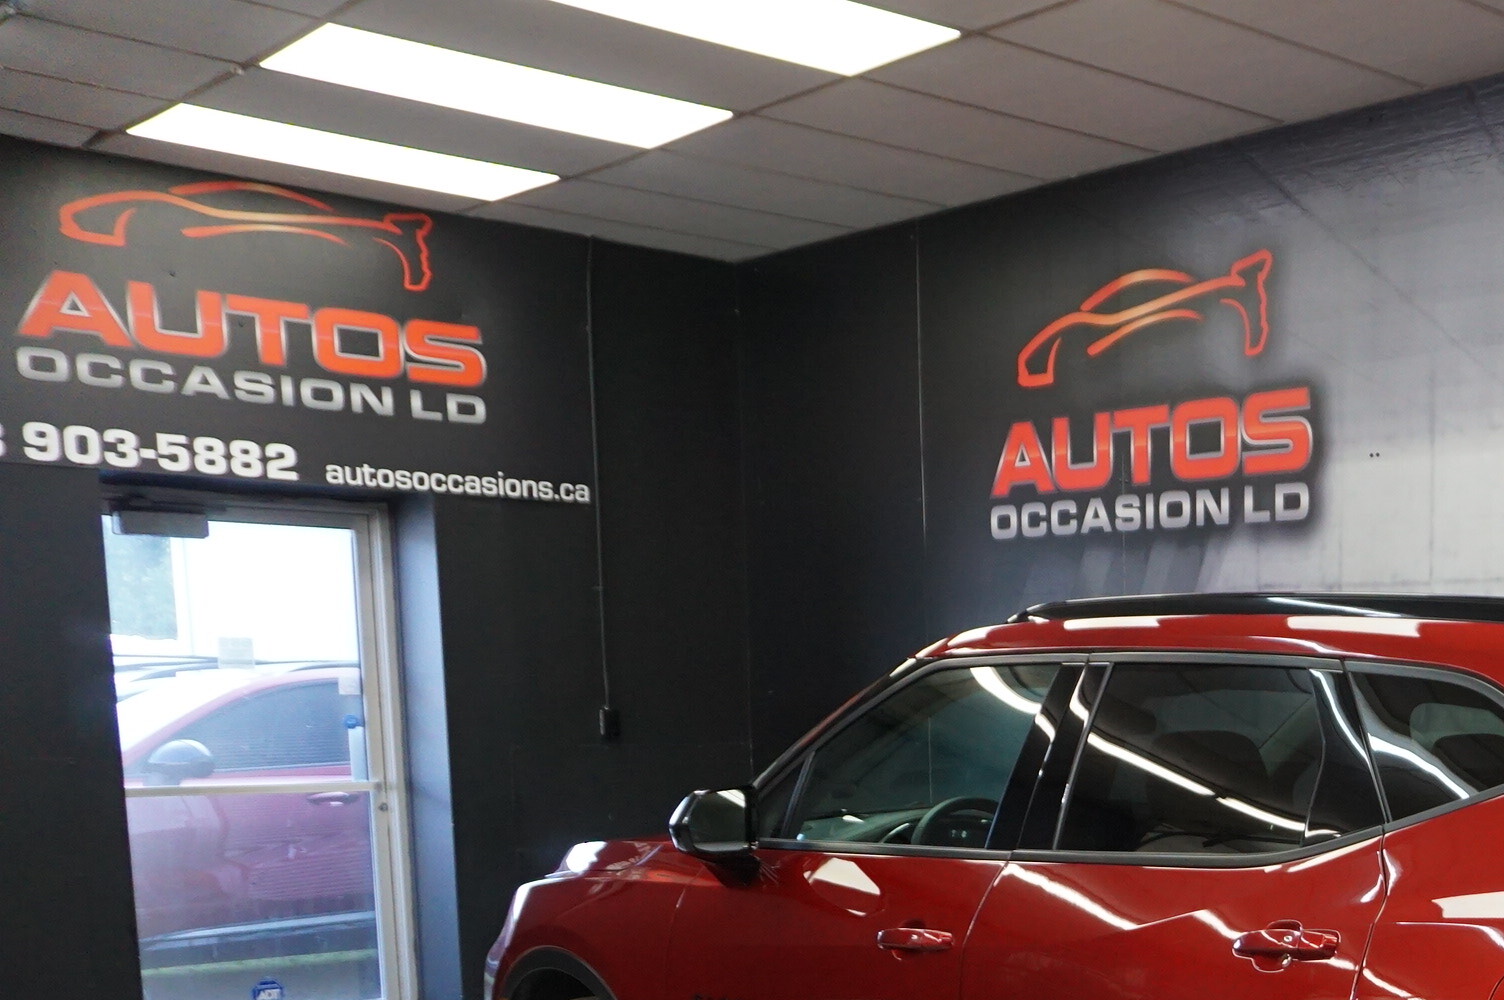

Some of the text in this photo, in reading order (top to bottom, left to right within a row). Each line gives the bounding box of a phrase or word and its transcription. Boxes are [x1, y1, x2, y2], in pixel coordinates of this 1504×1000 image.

[17, 269, 489, 388] AUTOS
[16, 346, 487, 425] OCCASION LD
[22, 421, 299, 481] 903-5882
[990, 387, 1313, 498] AUTOS
[325, 463, 591, 502] autosoccasions.ca
[990, 481, 1309, 540] OCCASION LD
